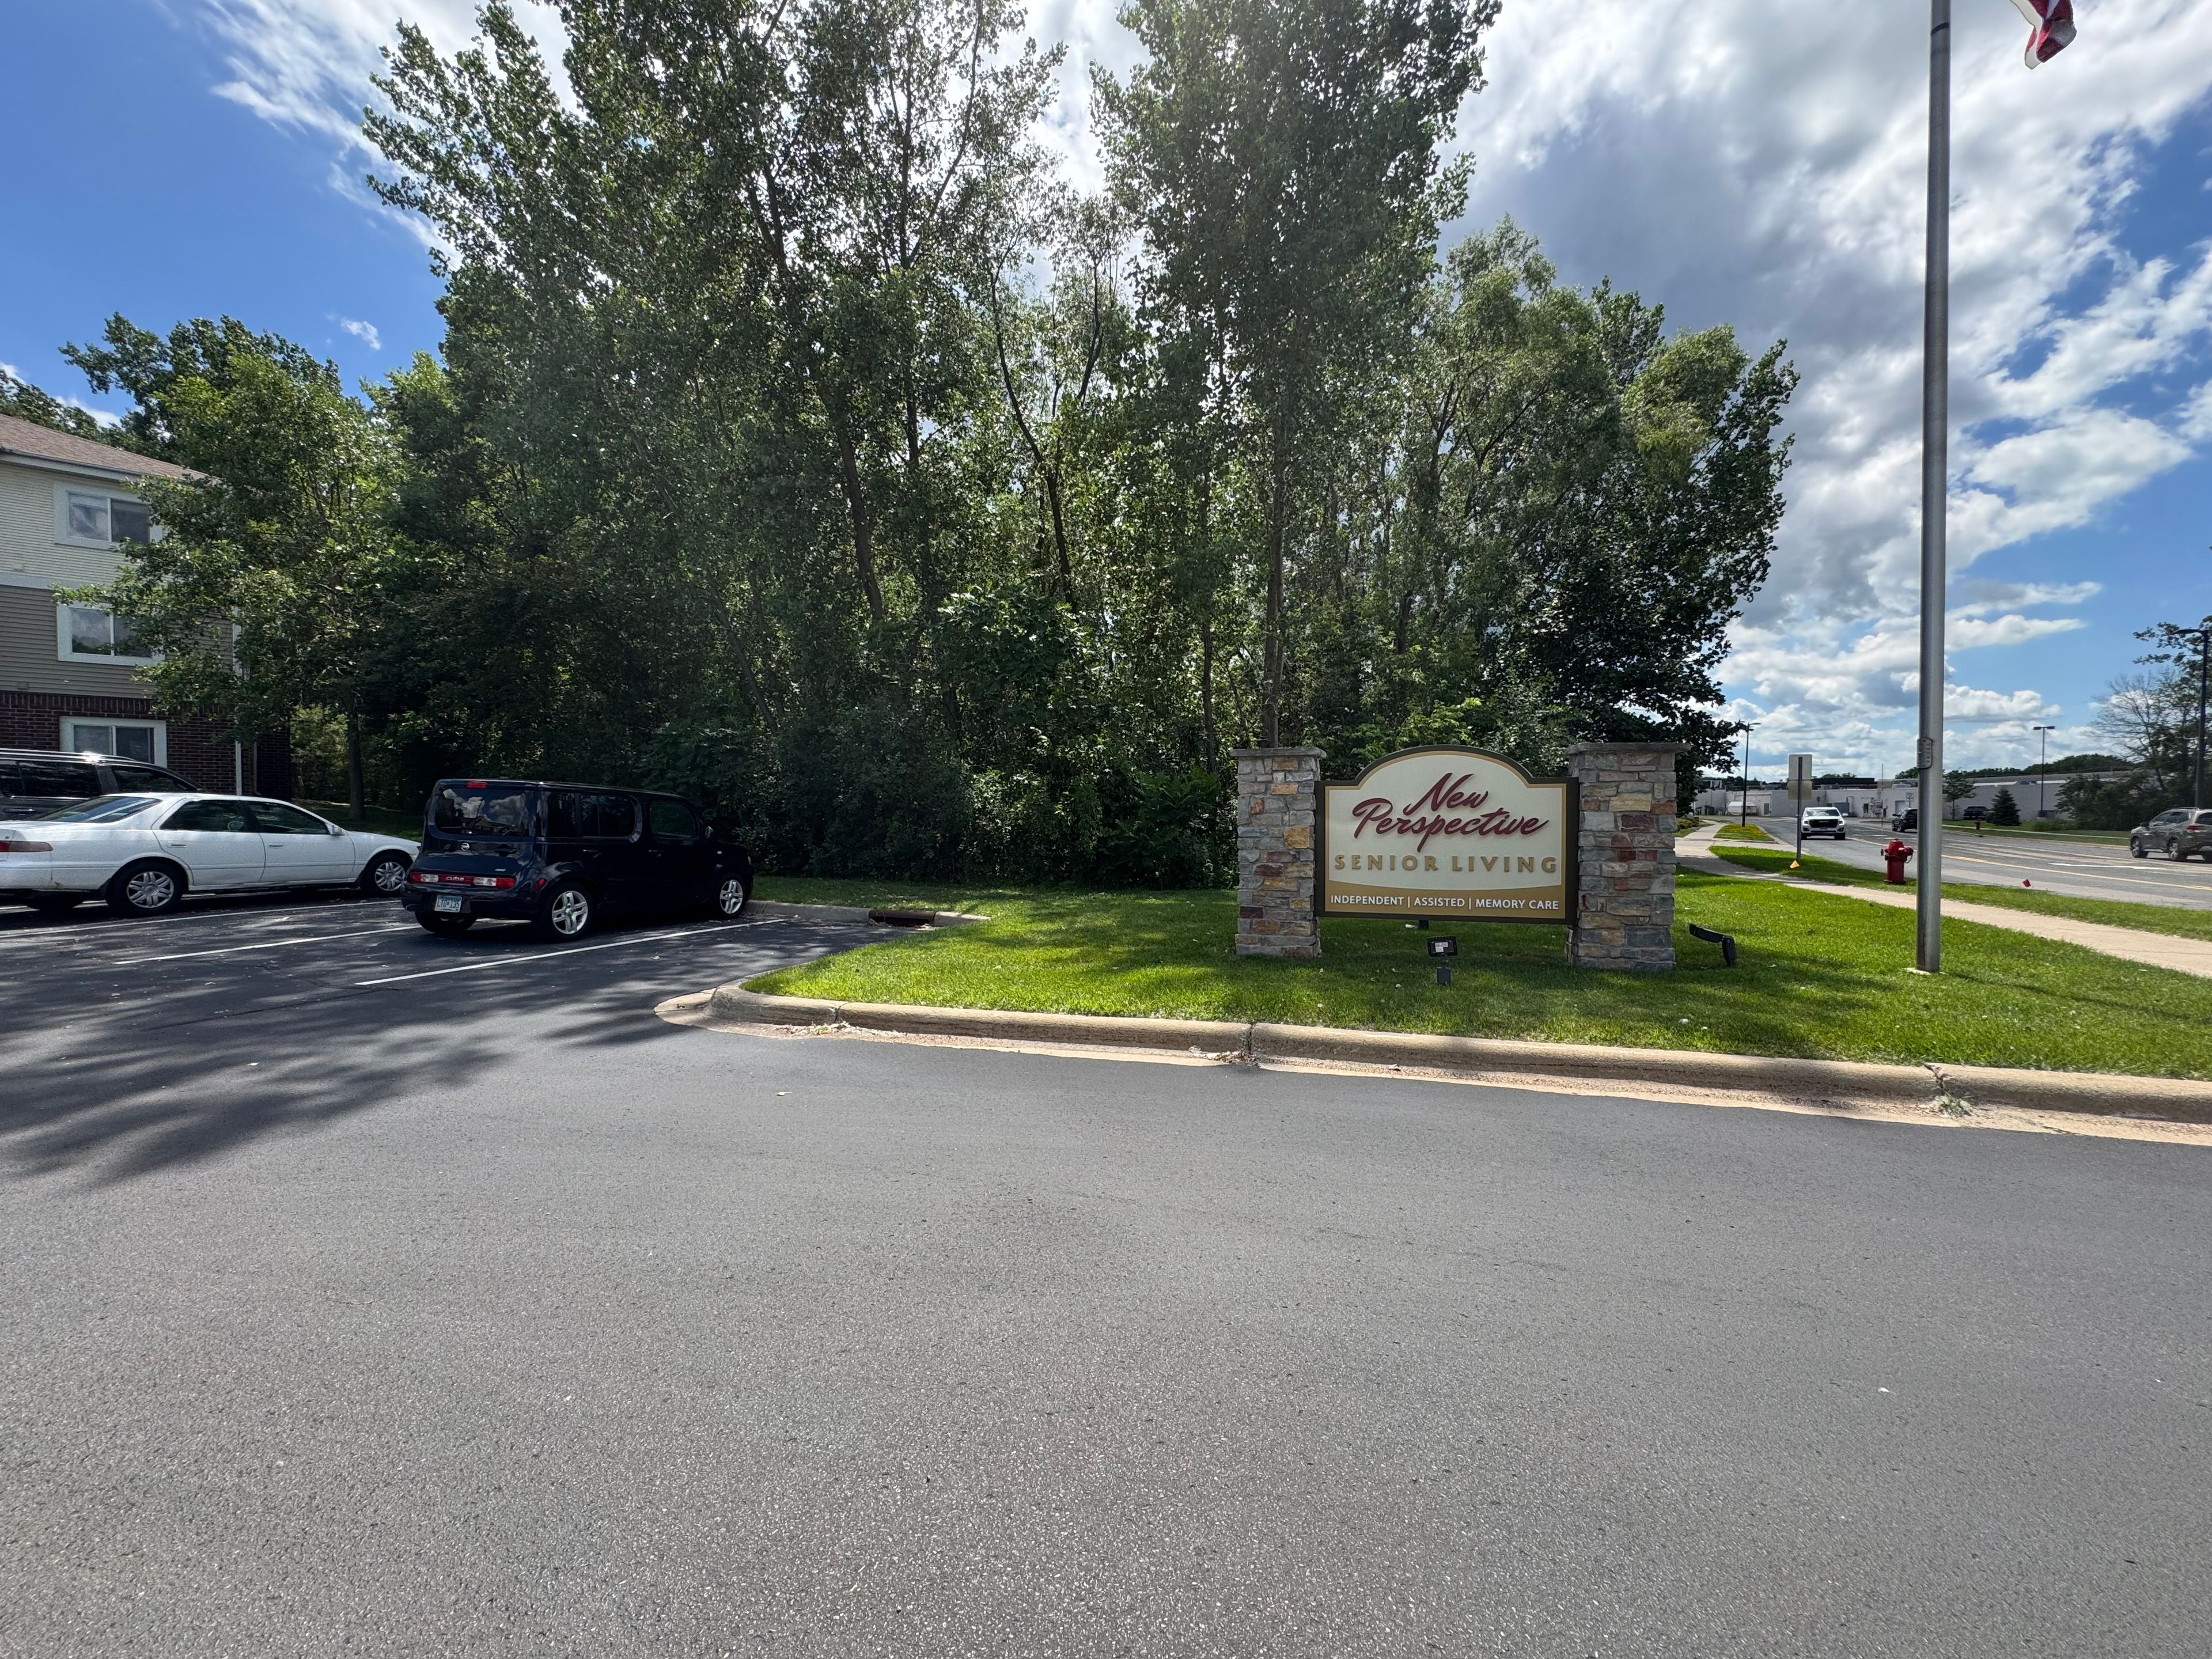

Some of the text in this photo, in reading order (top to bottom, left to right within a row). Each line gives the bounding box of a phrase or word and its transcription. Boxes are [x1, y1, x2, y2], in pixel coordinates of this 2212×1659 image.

[1403, 772, 1489, 816] New
[1352, 798, 1550, 853] Perspective
[1335, 854, 1556, 873] SENIOR LIVING
[1331, 895, 1404, 906] INDEPENDENT
[1414, 897, 1465, 907] ASSISTED
[1475, 899, 1526, 908] MEMORY
[1528, 900, 1559, 910] CARE
